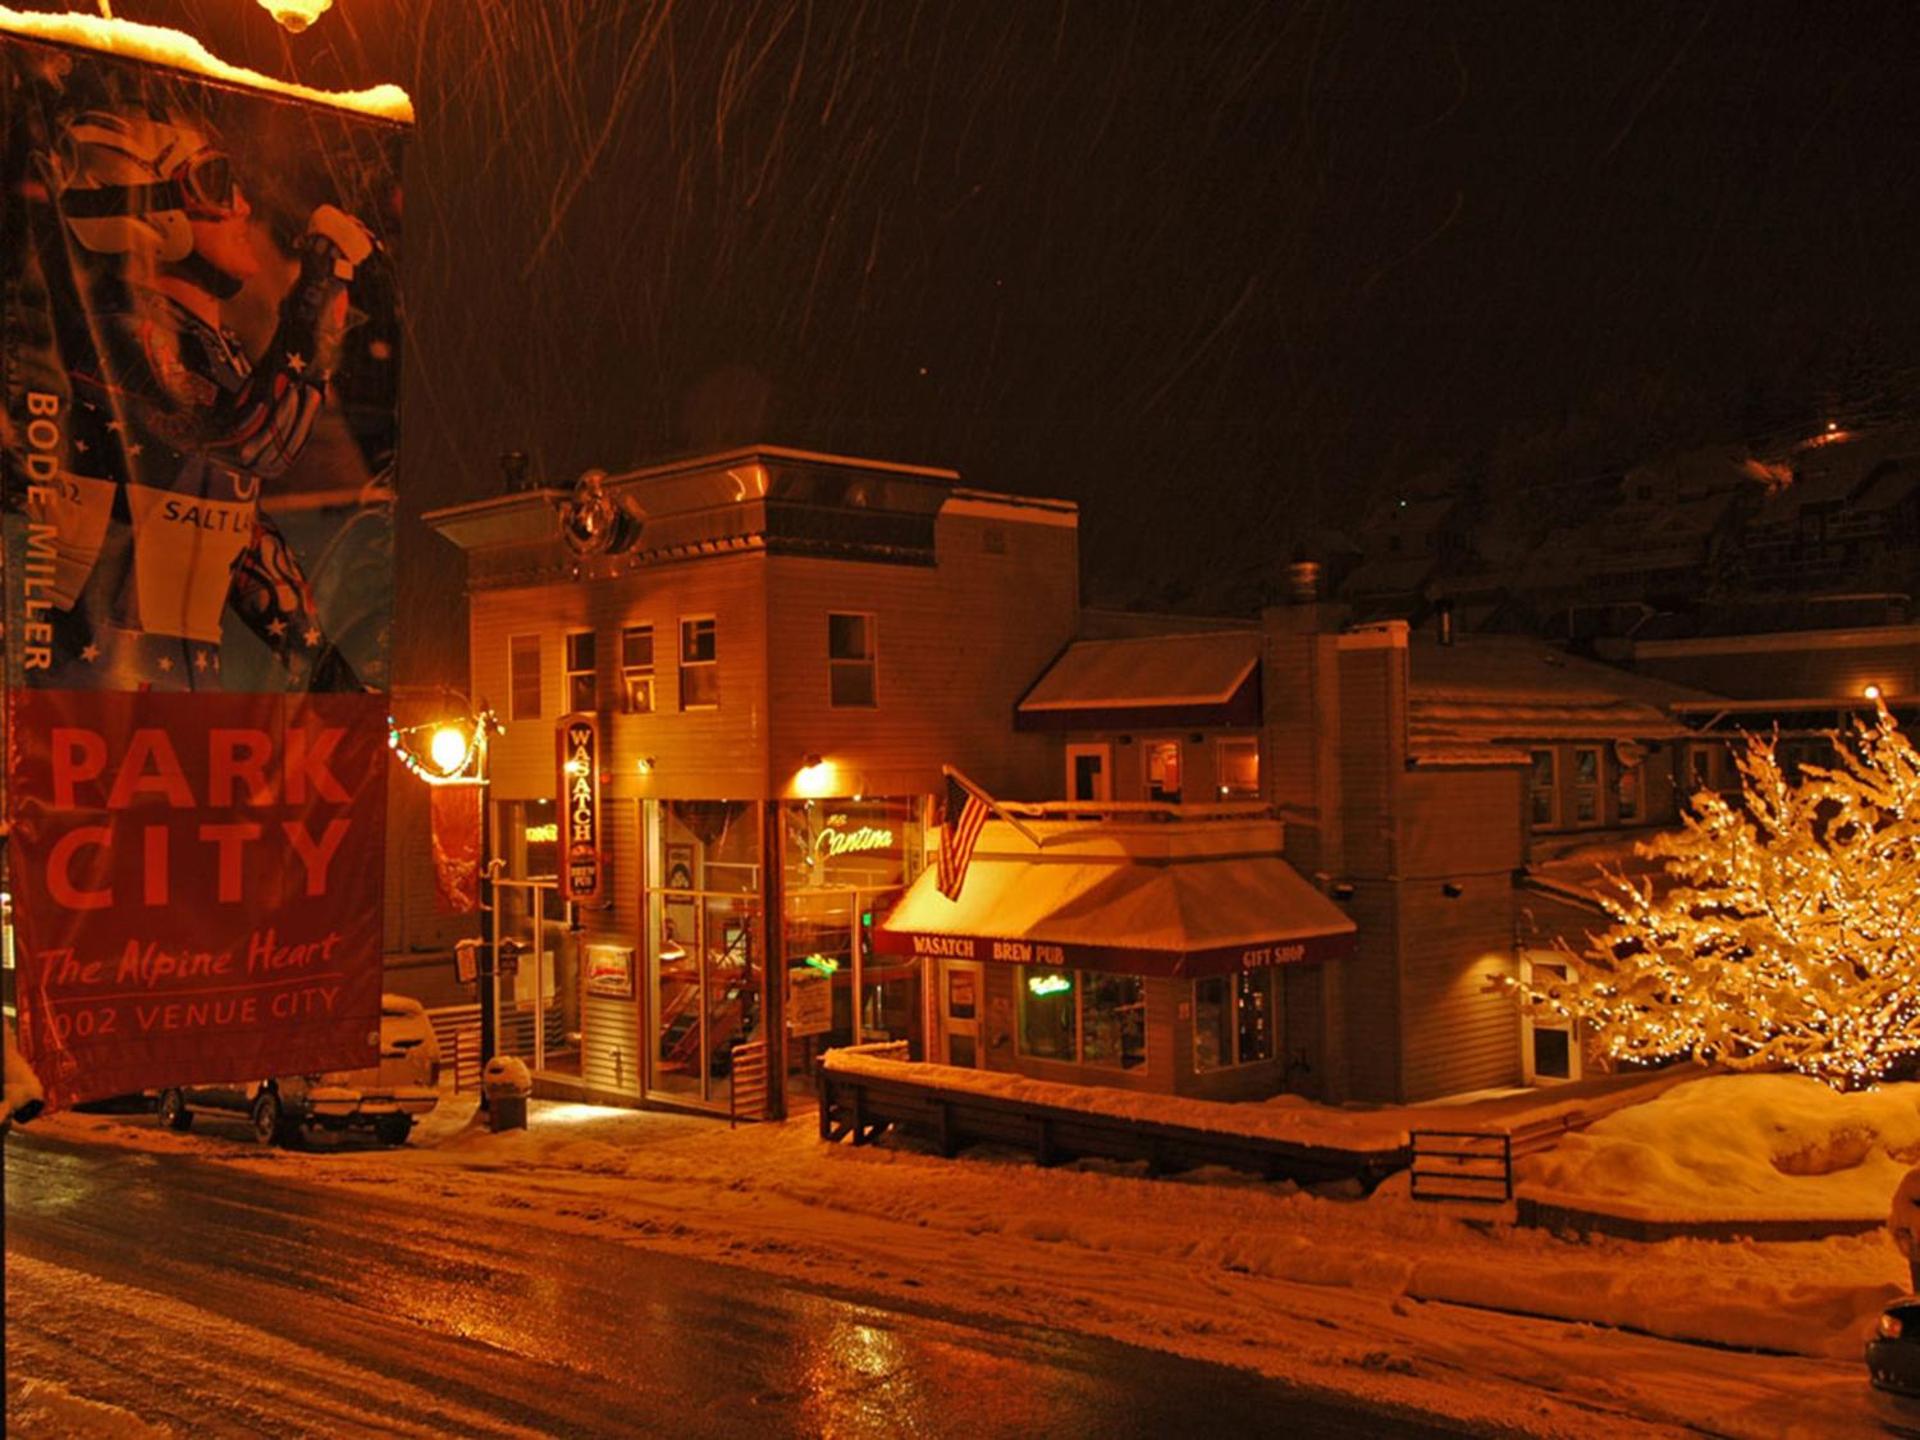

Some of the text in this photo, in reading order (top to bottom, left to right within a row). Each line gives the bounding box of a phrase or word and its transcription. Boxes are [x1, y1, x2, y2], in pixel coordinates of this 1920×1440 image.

[24, 392, 59, 670] BODE MILLER
[163, 500, 229, 530] SALT
[51, 727, 350, 810] PARK
[570, 729, 592, 841] WASATCH
[46, 818, 352, 909] CITY
[814, 826, 893, 860] Cantina
[36, 928, 342, 988] The Alpine Heart
[913, 935, 1064, 965] WASATCH BREW PUB
[1243, 944, 1305, 968] GIFT SHOP
[137, 996, 256, 1030] VENUE
[272, 986, 339, 1017] CITY
